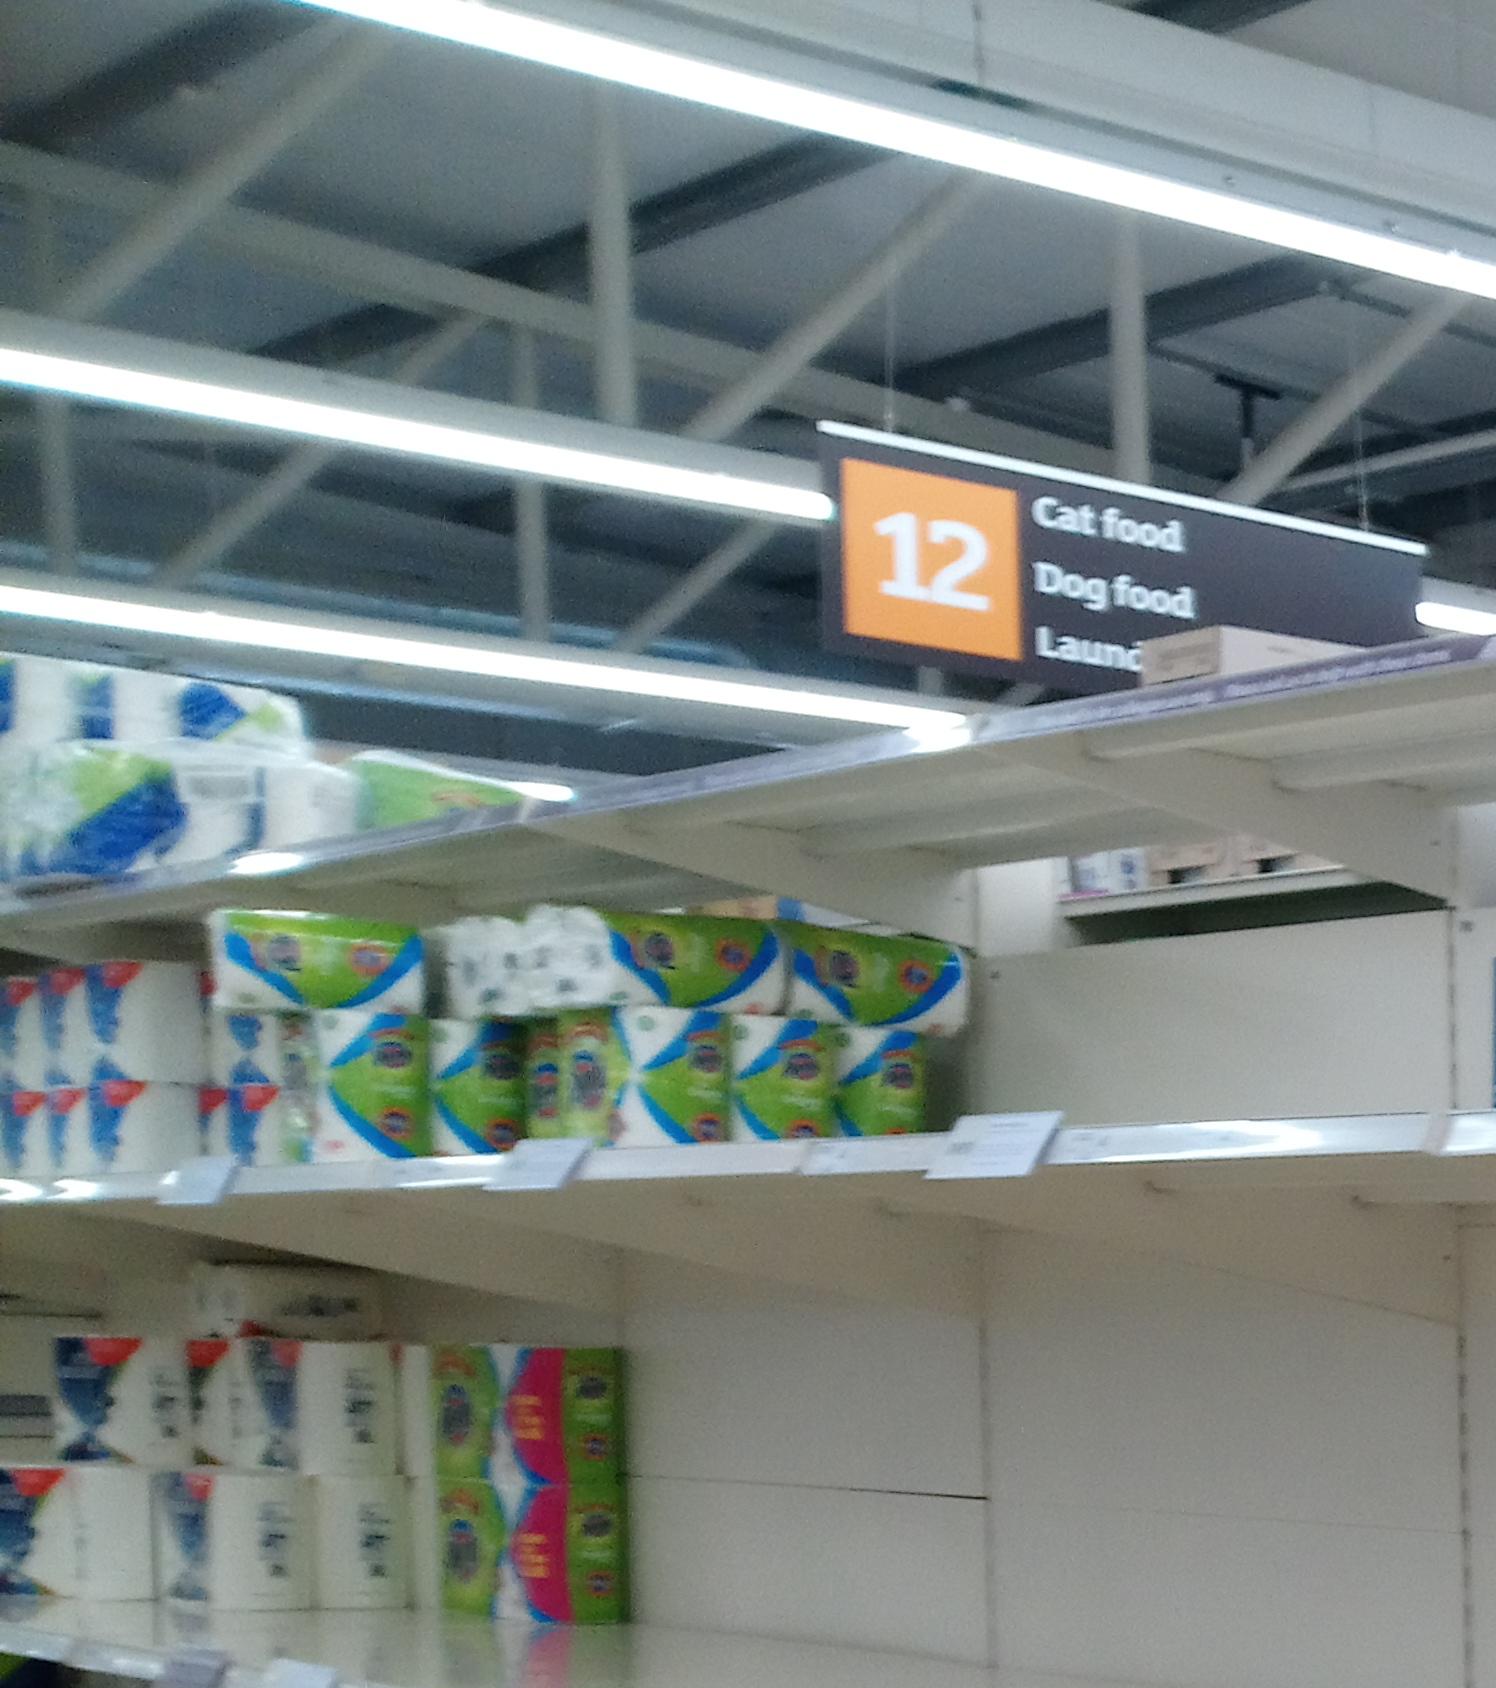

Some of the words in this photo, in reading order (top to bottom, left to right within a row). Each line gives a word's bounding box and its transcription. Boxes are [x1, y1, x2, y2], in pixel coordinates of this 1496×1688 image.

[1031, 495, 1098, 536] Cat
[1101, 506, 1186, 555] food
[872, 510, 991, 612] 12
[1033, 559, 1107, 612] Dog
[1110, 572, 1197, 621] food
